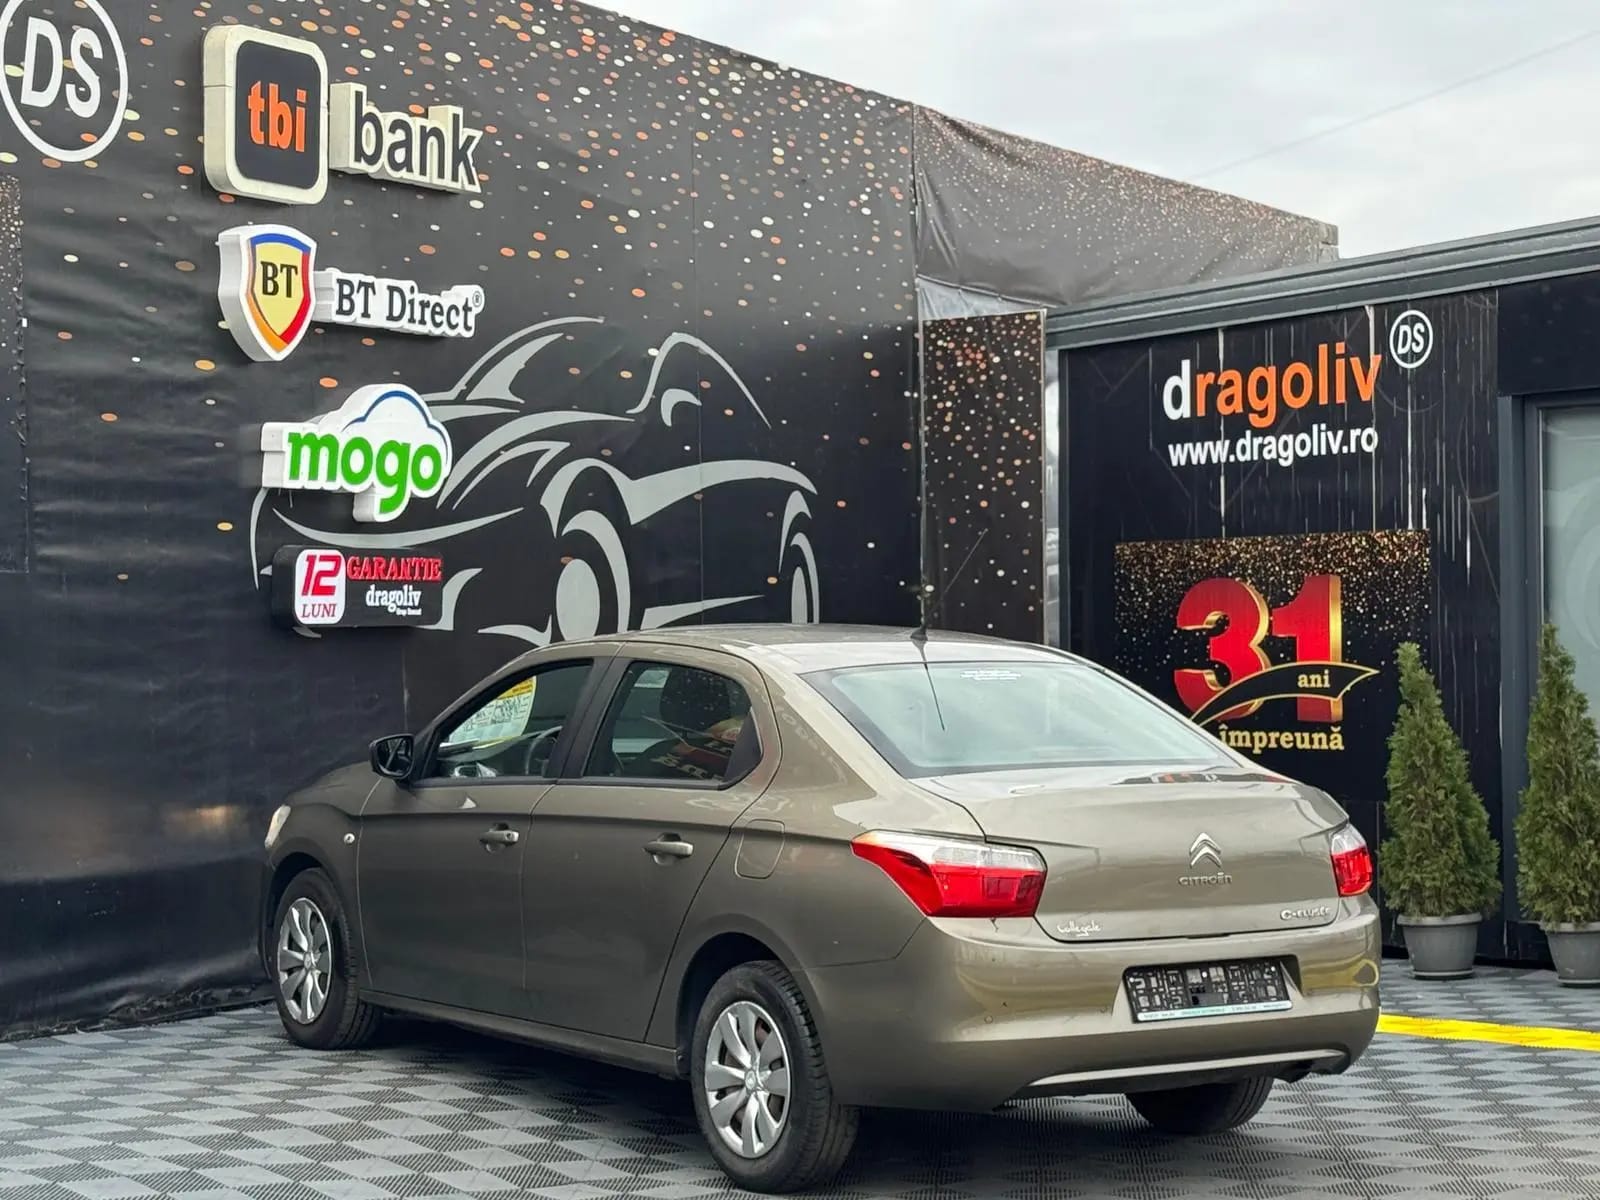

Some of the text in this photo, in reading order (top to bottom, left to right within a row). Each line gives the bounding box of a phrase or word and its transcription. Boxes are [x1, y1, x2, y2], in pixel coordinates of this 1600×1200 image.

[20, 15, 103, 119] DS
[247, 80, 307, 153] tbi
[353, 89, 481, 187] bank
[260, 260, 299, 299] BT
[335, 277, 377, 319] BT
[1397, 322, 1425, 355] DS
[1162, 341, 1382, 428] dragoliv
[1168, 424, 1379, 468] www.dragoliv.ro
[287, 431, 442, 515] mogo
[301, 554, 342, 597] 12
[346, 556, 442, 582] GARANTIE
[301, 602, 337, 619] LUNI
[365, 583, 422, 613] dragoliv
[1173, 574, 1344, 723] 31
[1297, 668, 1331, 690] ani
[1218, 723, 1345, 755] împreună
